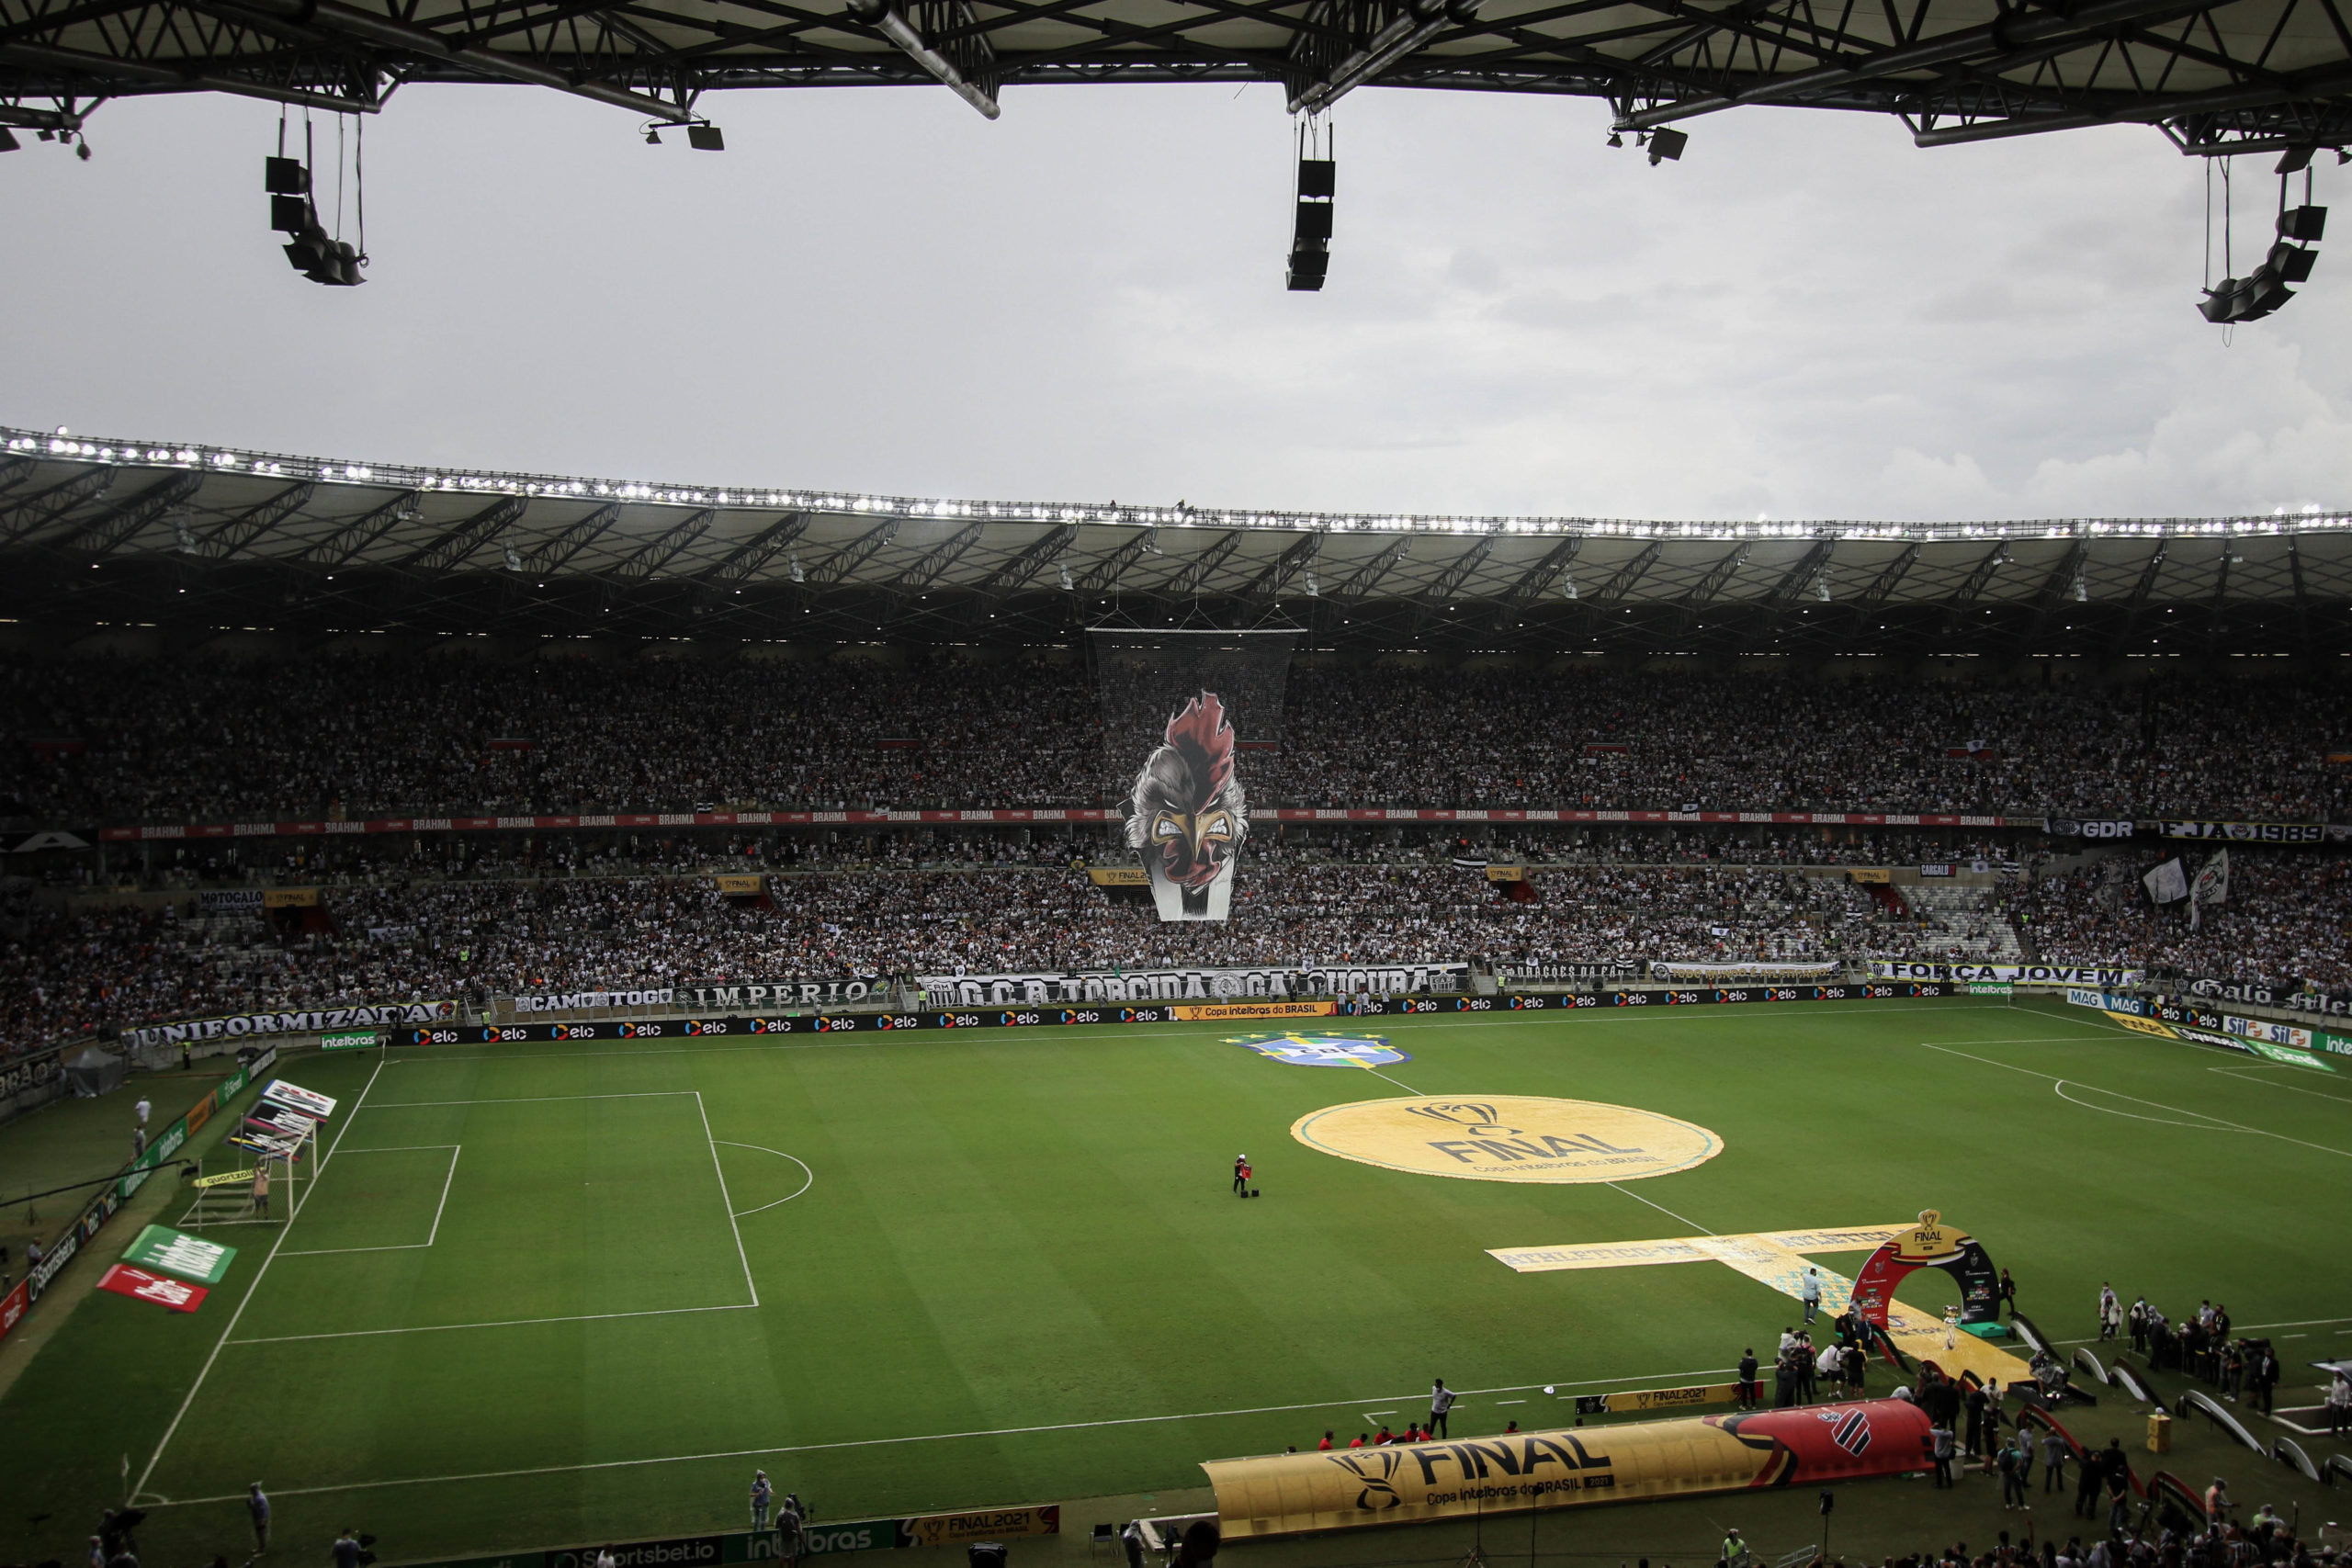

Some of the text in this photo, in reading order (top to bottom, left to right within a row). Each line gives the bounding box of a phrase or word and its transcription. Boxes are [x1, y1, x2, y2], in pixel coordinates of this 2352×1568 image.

[659, 814, 695, 825] BRAHMA
[737, 813, 772, 823] BRAHMA
[812, 812, 847, 823] BRAHMA
[888, 810, 921, 821] BRAHMA
[961, 810, 994, 820] BRAHMA
[1033, 810, 1066, 819] BRAHMA
[1316, 810, 1348, 819] BRAHMA
[1385, 810, 1418, 819] BRAHMA
[1456, 810, 1488, 819] BRAHMA
[1526, 810, 1558, 820] BRAHMA
[1597, 811, 1630, 821] BRAHMA
[1668, 812, 1701, 821] BRAHMA
[1739, 812, 1773, 822] BRAHMA
[1812, 814, 1845, 823] BRAHMA
[1885, 815, 1919, 825] BRAHMA
[1961, 816, 1996, 826] BRAHMA
[413, 819, 452, 830] BRAHMA
[497, 818, 535, 829] BRAHMA
[579, 816, 616, 827] BRAHMA
[141, 827, 186, 838] BRAHMA
[233, 824, 276, 835] BRAHMA
[2082, 821, 2133, 838] GDR
[2161, 822, 2323, 841] FJA 1989
[732, 880, 750, 888] FINAL
[1672, 968, 1702, 978] TODO
[2014, 966, 2122, 985] JOVEM
[1727, 990, 1747, 1002] elo
[1777, 988, 1797, 1001] elo
[1826, 987, 1845, 999] elo
[1874, 986, 1893, 998] elo
[1921, 985, 1940, 997] elo
[1970, 984, 2012, 995] intelbras
[530, 994, 582, 1010] CAM
[1469, 998, 1492, 1011] elo
[1523, 997, 1544, 1010] elo
[1575, 995, 1595, 1008] elo
[1626, 993, 1647, 1006] elo
[1678, 992, 1698, 1005] elo
[2071, 990, 2098, 1007] MAG
[2110, 997, 2140, 1013] MAG
[1205, 1003, 1317, 1017] Copa intelbras do BRASIL
[1416, 1000, 1438, 1012] elo
[956, 1014, 979, 1027] elo
[1017, 1012, 1040, 1025] elo
[1077, 1010, 1100, 1023] elo
[1136, 1009, 1159, 1021] elo
[2162, 1007, 2180, 1021] elo
[768, 1020, 792, 1033] elo
[831, 1018, 854, 1031] elo
[894, 1016, 917, 1029] elo
[2199, 1013, 2218, 1029] elo
[2228, 1017, 2247, 1035] Sil
[502, 1027, 527, 1041] elo
[570, 1025, 595, 1039] elo
[637, 1023, 662, 1037] elo
[702, 1021, 728, 1035] elo
[2270, 1025, 2290, 1043] Sil
[322, 1033, 376, 1049] intelbras
[432, 1031, 459, 1044] elo
[1427, 1134, 1645, 1163] FINAL
[1472, 1164, 1514, 1173] Copa
[207, 1169, 255, 1186] quartzoli
[1915, 1231, 1942, 1244] FINAL
[1410, 1434, 1612, 1485] FINAL
[1427, 1477, 1610, 1509] Copa intelbras do BRASIL 2021
[1005, 1525, 1029, 1535] BRASIL
[747, 1527, 872, 1562] intlbras
[582, 1541, 715, 1568] Sortsbet.io
